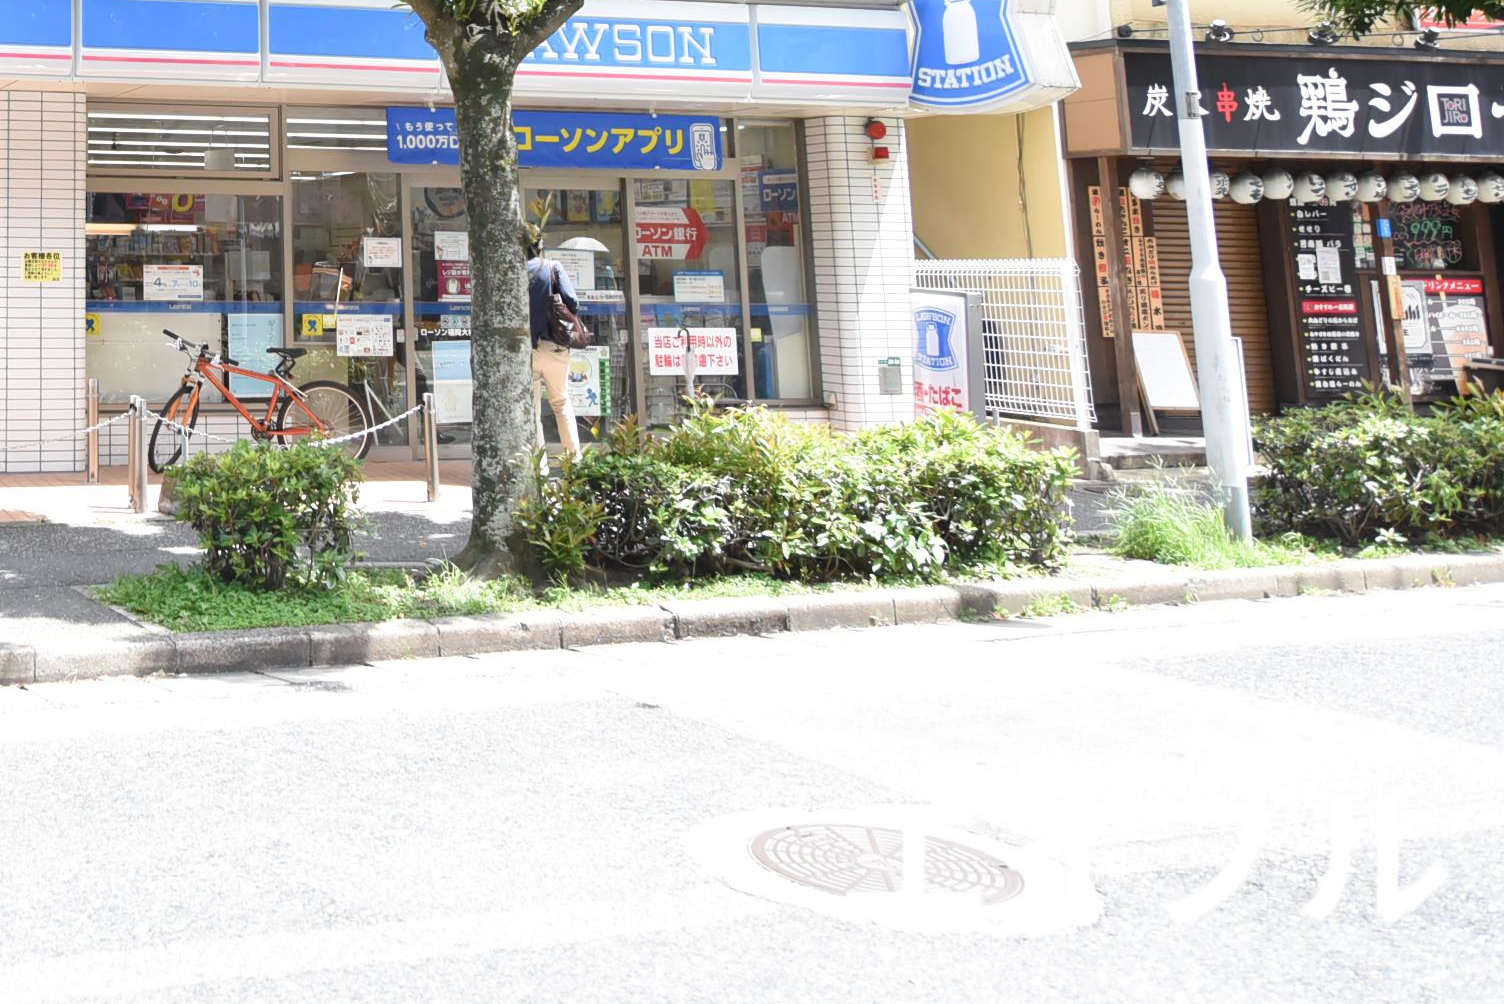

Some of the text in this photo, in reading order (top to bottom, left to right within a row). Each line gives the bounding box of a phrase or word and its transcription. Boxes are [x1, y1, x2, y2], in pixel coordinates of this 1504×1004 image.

[526, 22, 717, 66] WSON
[917, 54, 1014, 89] STATION
[1297, 67, 1504, 145] 鶏ジロ
[404, 121, 454, 132] もう使って
[512, 126, 684, 155] ローソンアプリ
[642, 245, 673, 258] ATM
[654, 335, 732, 349] 当店ご利用時以外の
[655, 354, 733, 368] 駐輪は慮下さい
